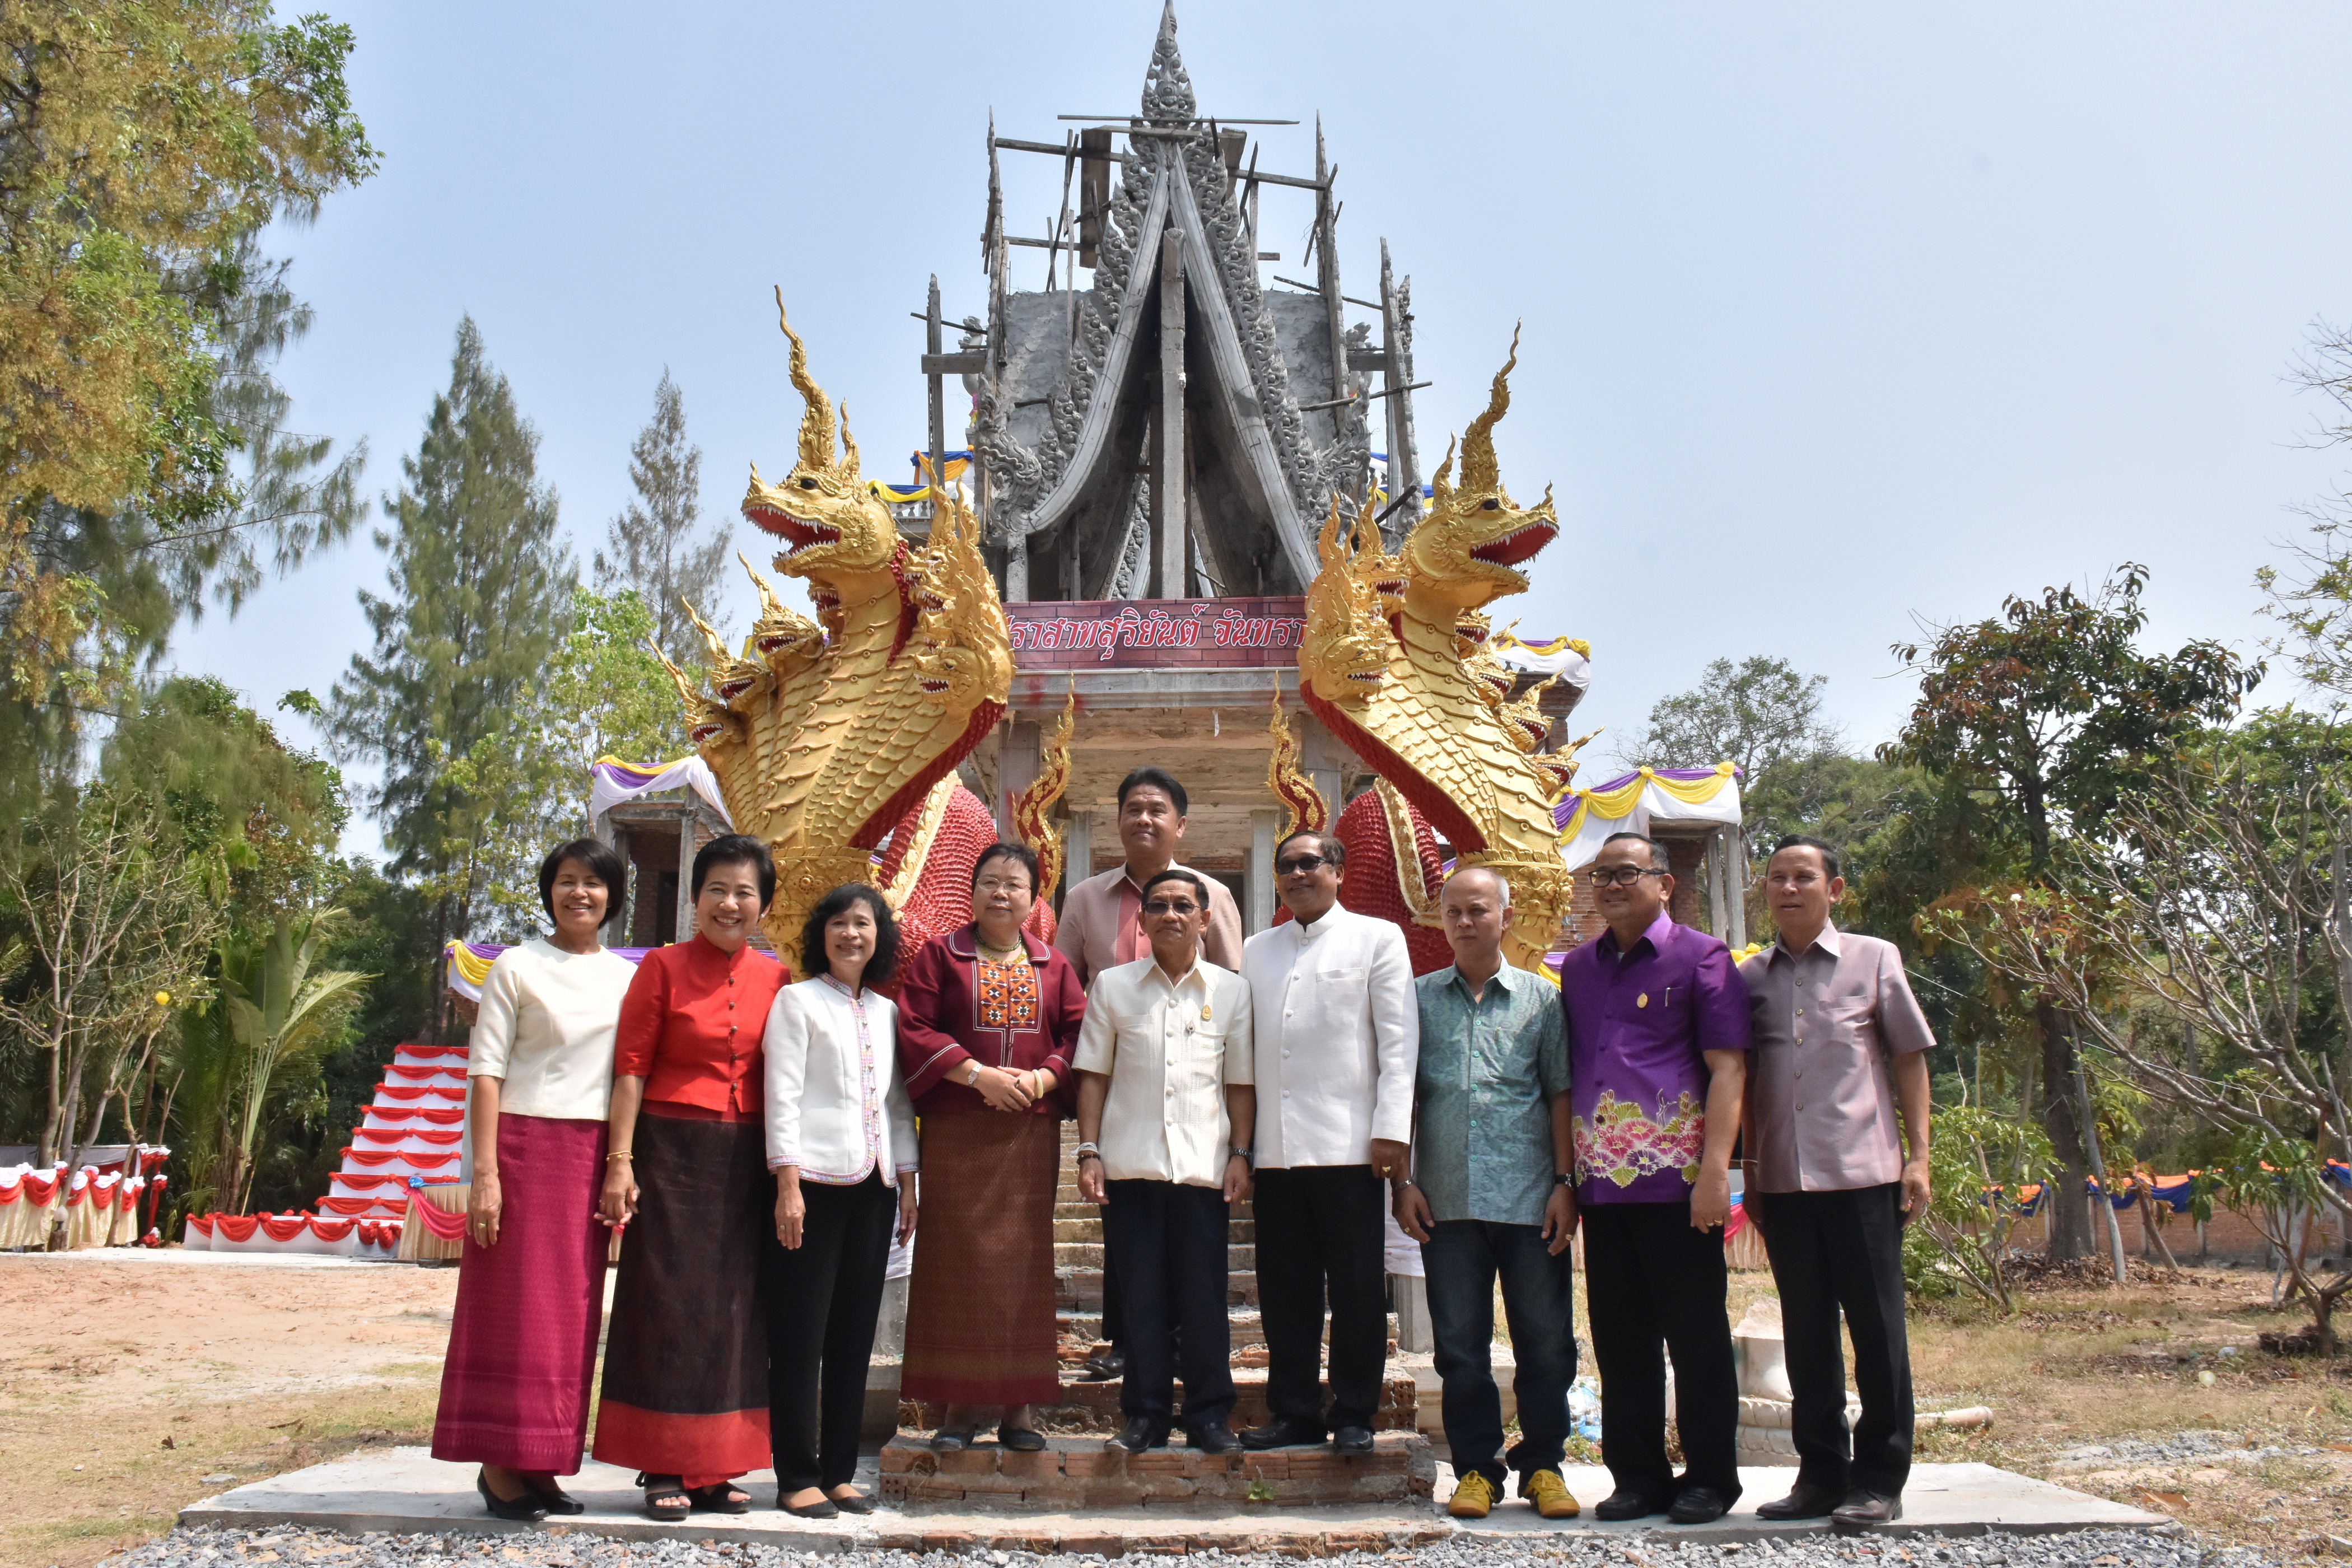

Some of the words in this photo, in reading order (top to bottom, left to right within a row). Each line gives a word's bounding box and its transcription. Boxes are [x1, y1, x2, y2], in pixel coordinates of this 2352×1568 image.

[1007, 603, 1210, 661] ราสาทสุริยันต์
